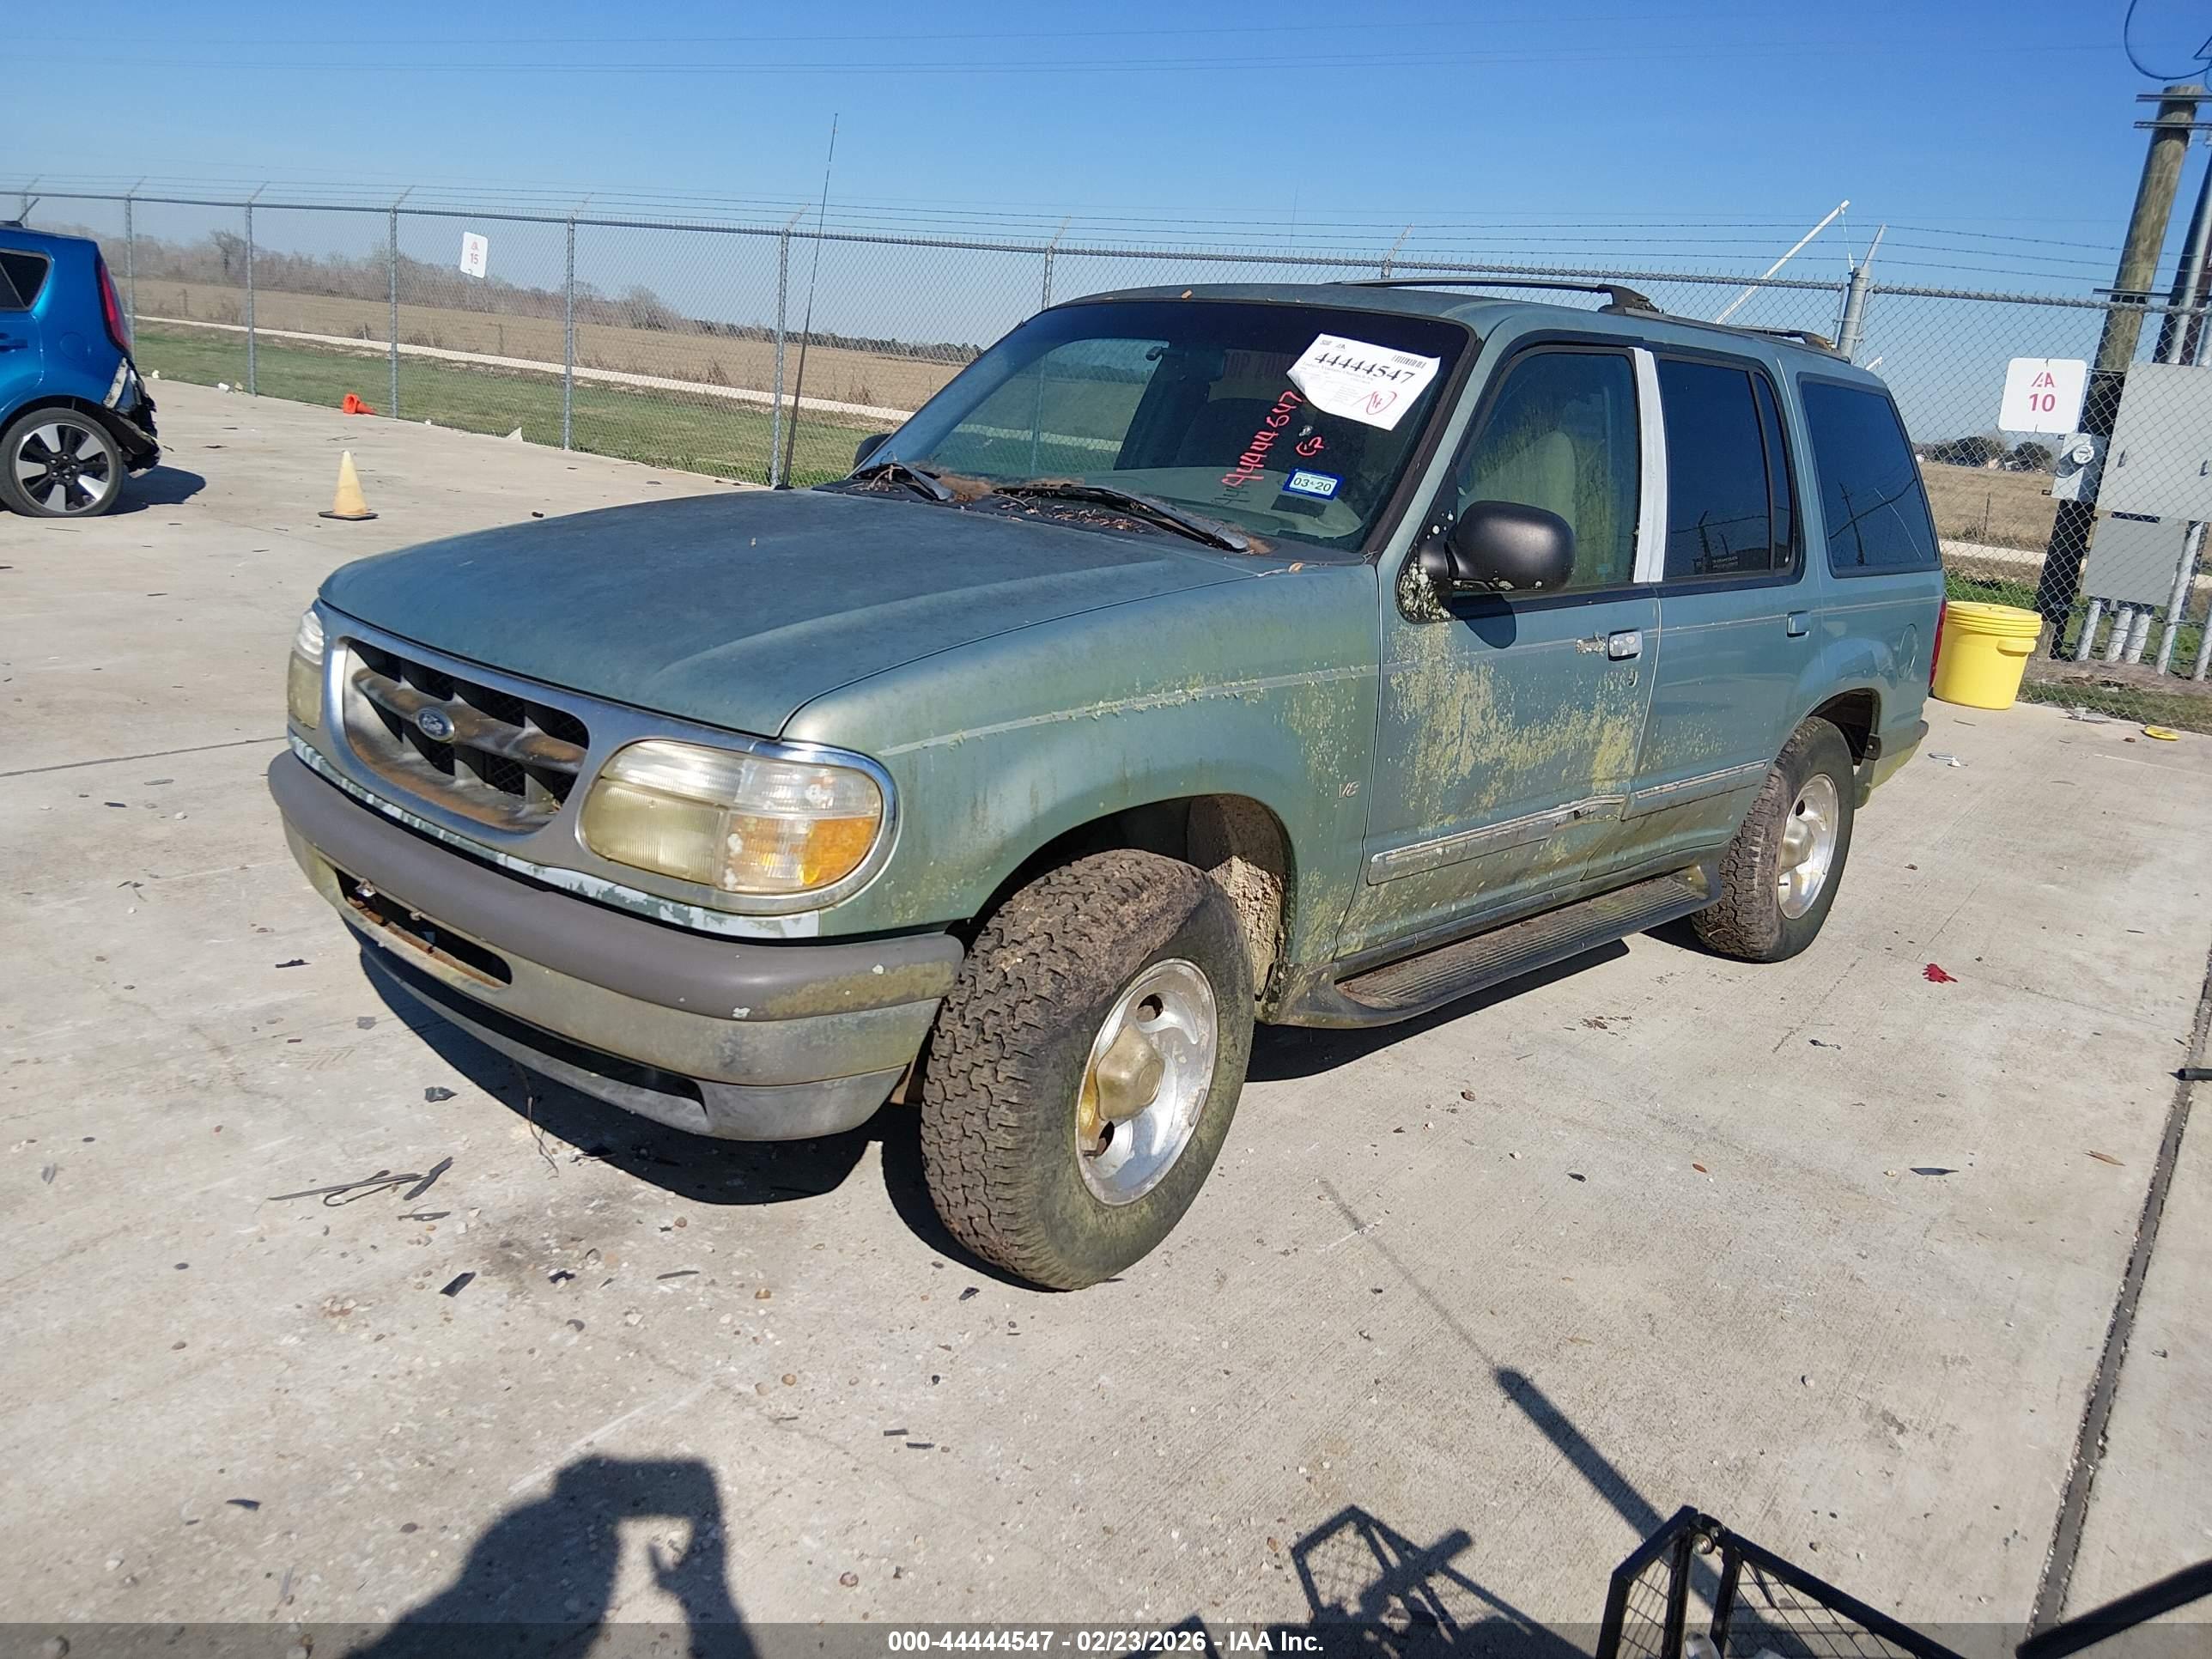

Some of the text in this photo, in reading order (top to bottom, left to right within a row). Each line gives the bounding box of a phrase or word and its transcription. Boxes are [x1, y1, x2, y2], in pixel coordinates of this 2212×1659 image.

[471, 253, 479, 264] 15
[1315, 352, 1416, 384] 44444547
[2029, 393, 2056, 412] 10
[1315, 481, 1332, 492] 20
